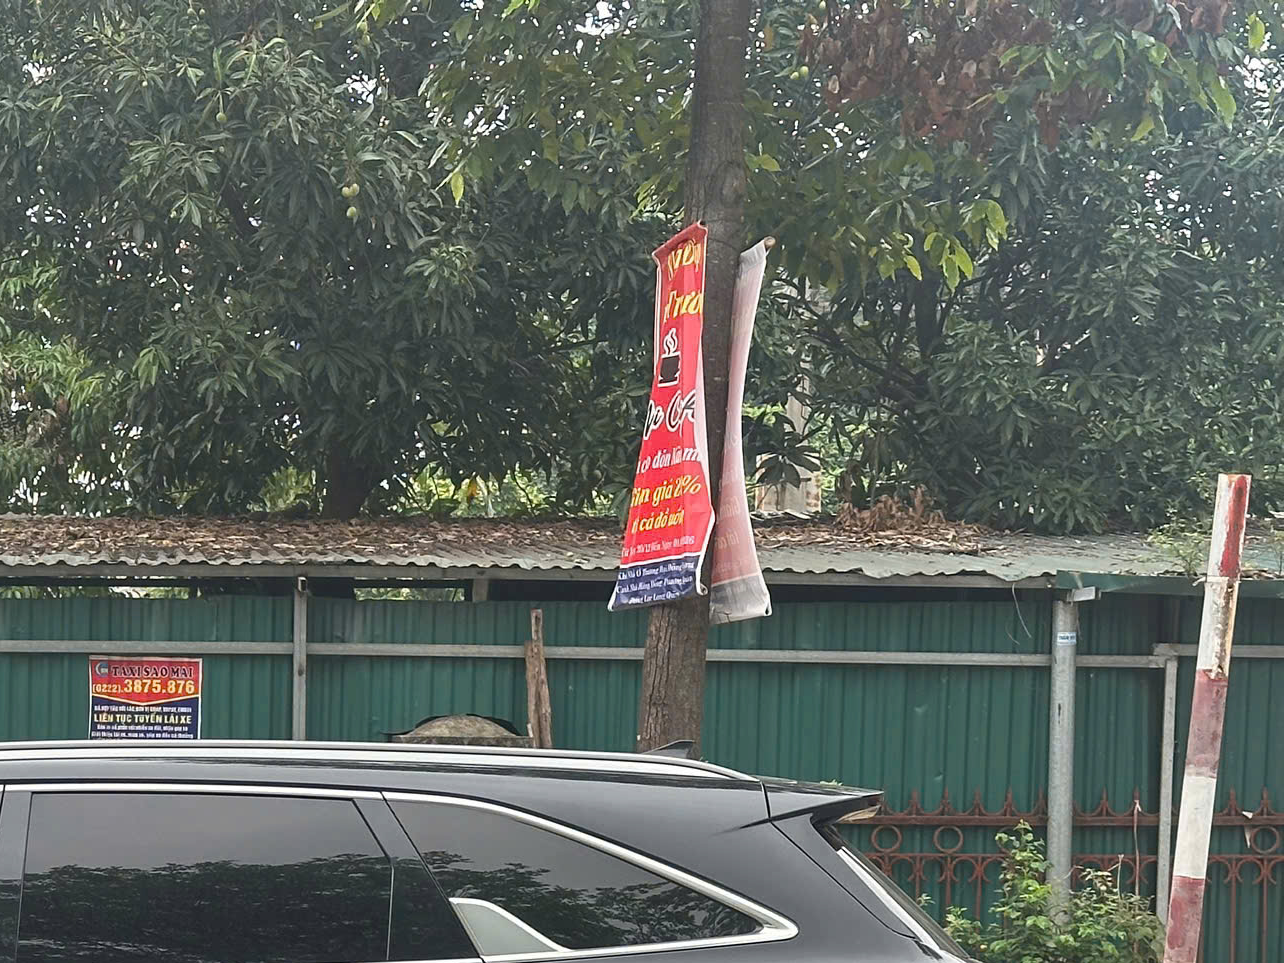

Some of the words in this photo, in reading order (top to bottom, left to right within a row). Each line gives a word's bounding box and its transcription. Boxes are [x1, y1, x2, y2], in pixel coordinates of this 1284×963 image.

[111, 665, 141, 678] TAXI
[143, 665, 168, 678] SAO
[171, 665, 194, 679] MAI
[94, 712, 113, 722] LIÊN
[116, 713, 132, 724] TỤC
[164, 713, 179, 723] LÁI
[180, 715, 192, 724] XE
